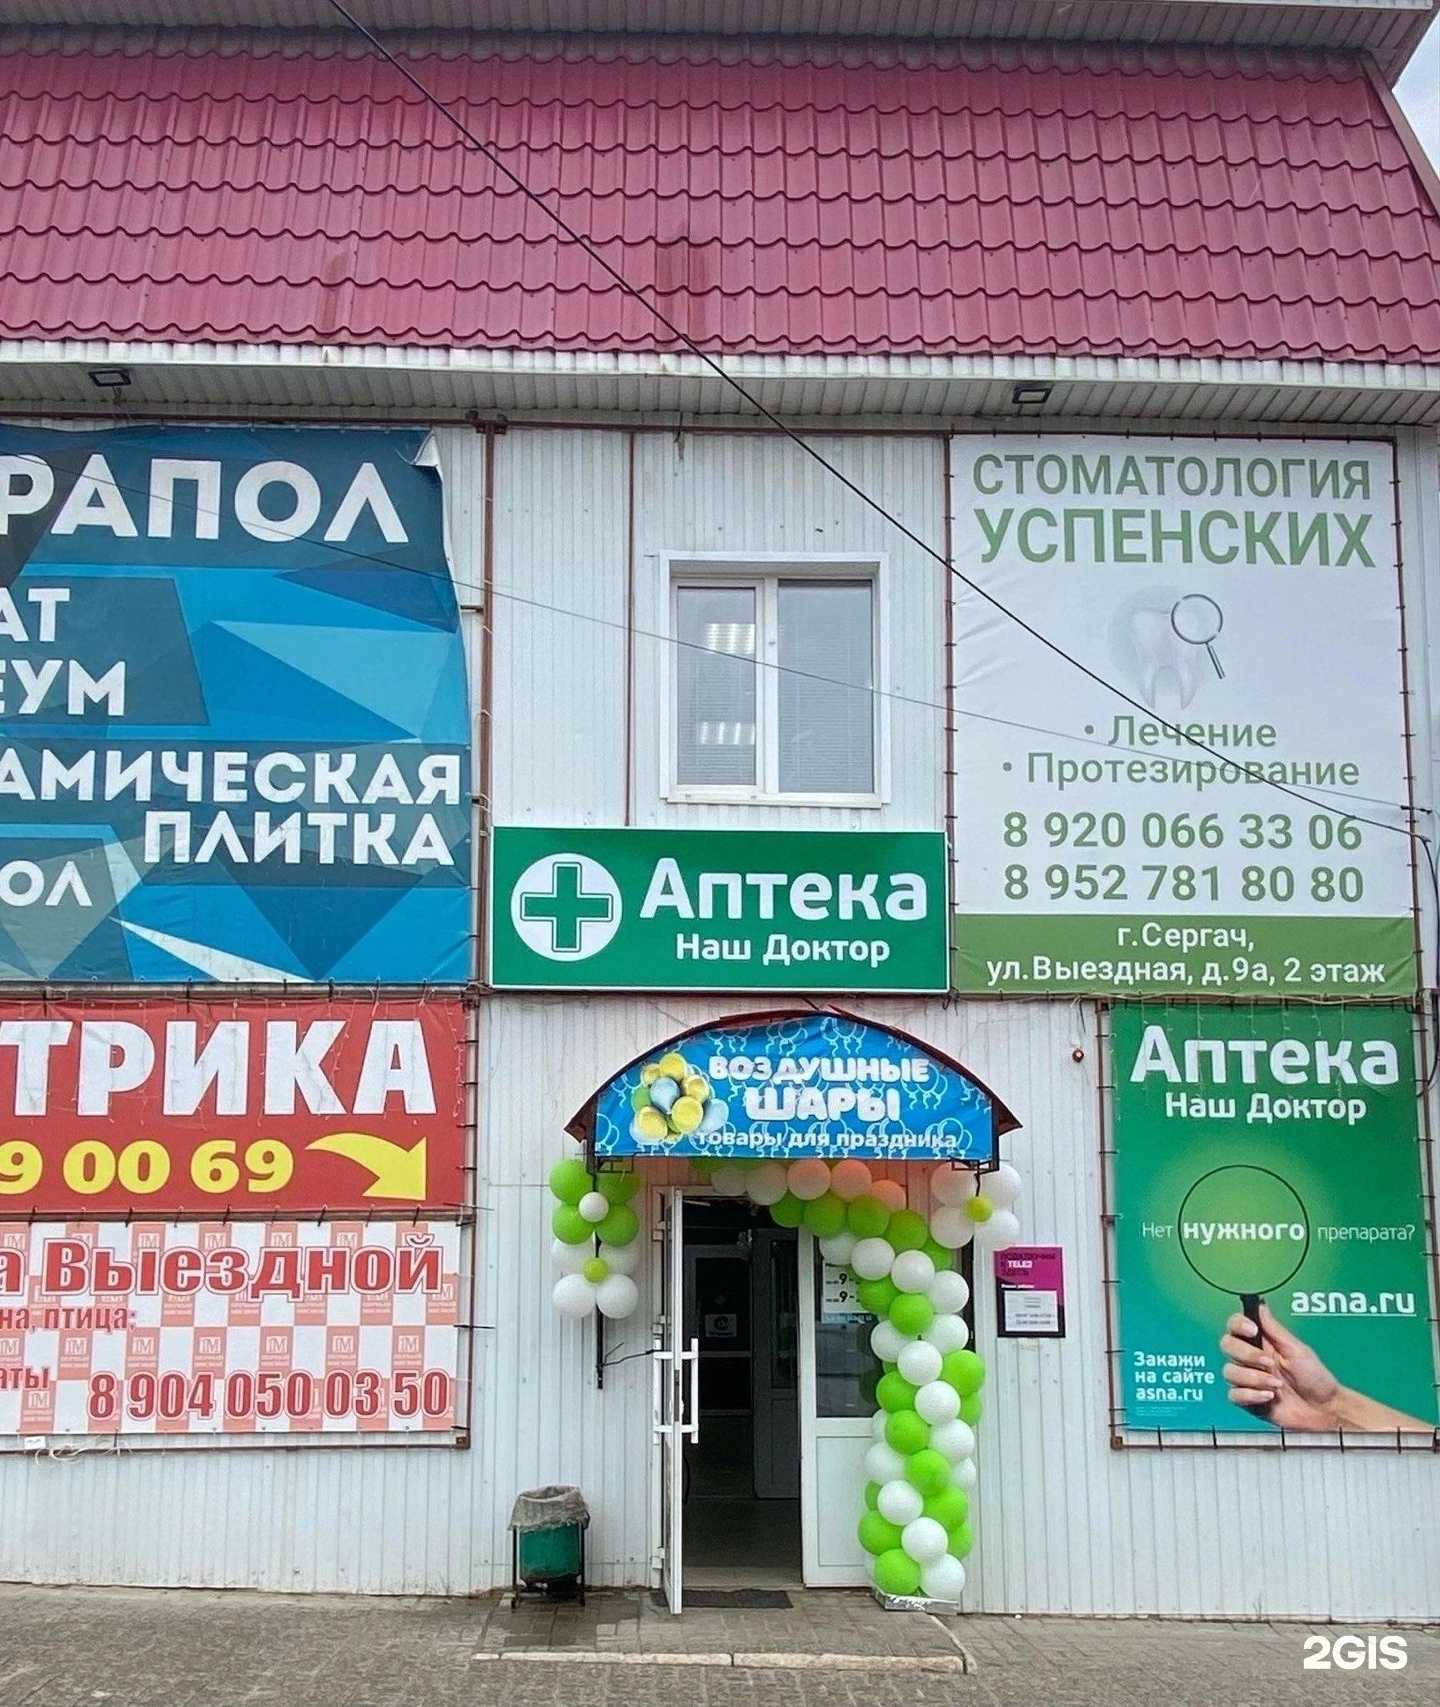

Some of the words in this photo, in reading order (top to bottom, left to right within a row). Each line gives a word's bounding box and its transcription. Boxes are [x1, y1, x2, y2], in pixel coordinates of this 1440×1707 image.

[972, 453, 1371, 500] СТОМАТОЛОГИЯ
[975, 508, 1377, 568] УСПЕНСКИХ
[1108, 715, 1277, 748] Лечение
[1027, 752, 1360, 791] Протезирование
[143, 810, 455, 865] ПЛИТКА
[1003, 811, 1028, 848] 8
[1043, 811, 1126, 848] 920
[1142, 812, 1224, 849] 066
[1239, 813, 1293, 850] 33
[1308, 814, 1362, 850] 06
[639, 857, 928, 921] Аптека
[1004, 864, 1029, 900] 8
[1045, 864, 1128, 901] 952
[1142, 865, 1219, 901] 781
[1241, 865, 1295, 902] 80
[1310, 866, 1364, 902] 80
[676, 933, 751, 961] Наш
[762, 934, 890, 967] Доктор
[1117, 922, 1255, 952] г.Сергач,
[986, 956, 1193, 986] ул.Выездная,
[1202, 957, 1275, 987] д.9а,
[1284, 957, 1302, 982] 2
[1310, 962, 1386, 983] этаж
[709, 1056, 930, 1084] ВОЗДУШНЫЕ
[1130, 1025, 1399, 1085] Аптека
[746, 1087, 901, 1121] ШАРЫ
[1166, 1093, 1235, 1119] Наш
[1247, 1093, 1367, 1125] Доктор
[789, 1131, 831, 1149] для
[837, 1131, 957, 1149] праздника
[62, 1139, 171, 1195] 00
[190, 1139, 294, 1194] 69
[1142, 1222, 1173, 1238] Нет
[1183, 1223, 1305, 1245] нужного
[1317, 1224, 1415, 1242] препарата?
[43, 1234, 442, 1302] Выездной
[1291, 1289, 1416, 1316] asna.ru
[1134, 1351, 1206, 1367] Закажи
[1135, 1371, 1157, 1383] на
[1162, 1368, 1215, 1384] сайте
[89, 1371, 116, 1420] 8
[128, 1371, 214, 1420] 904
[226, 1370, 313, 1420] 050
[324, 1370, 382, 1419] 03
[393, 1369, 450, 1419] 50
[1136, 1387, 1204, 1401] asna.ru
